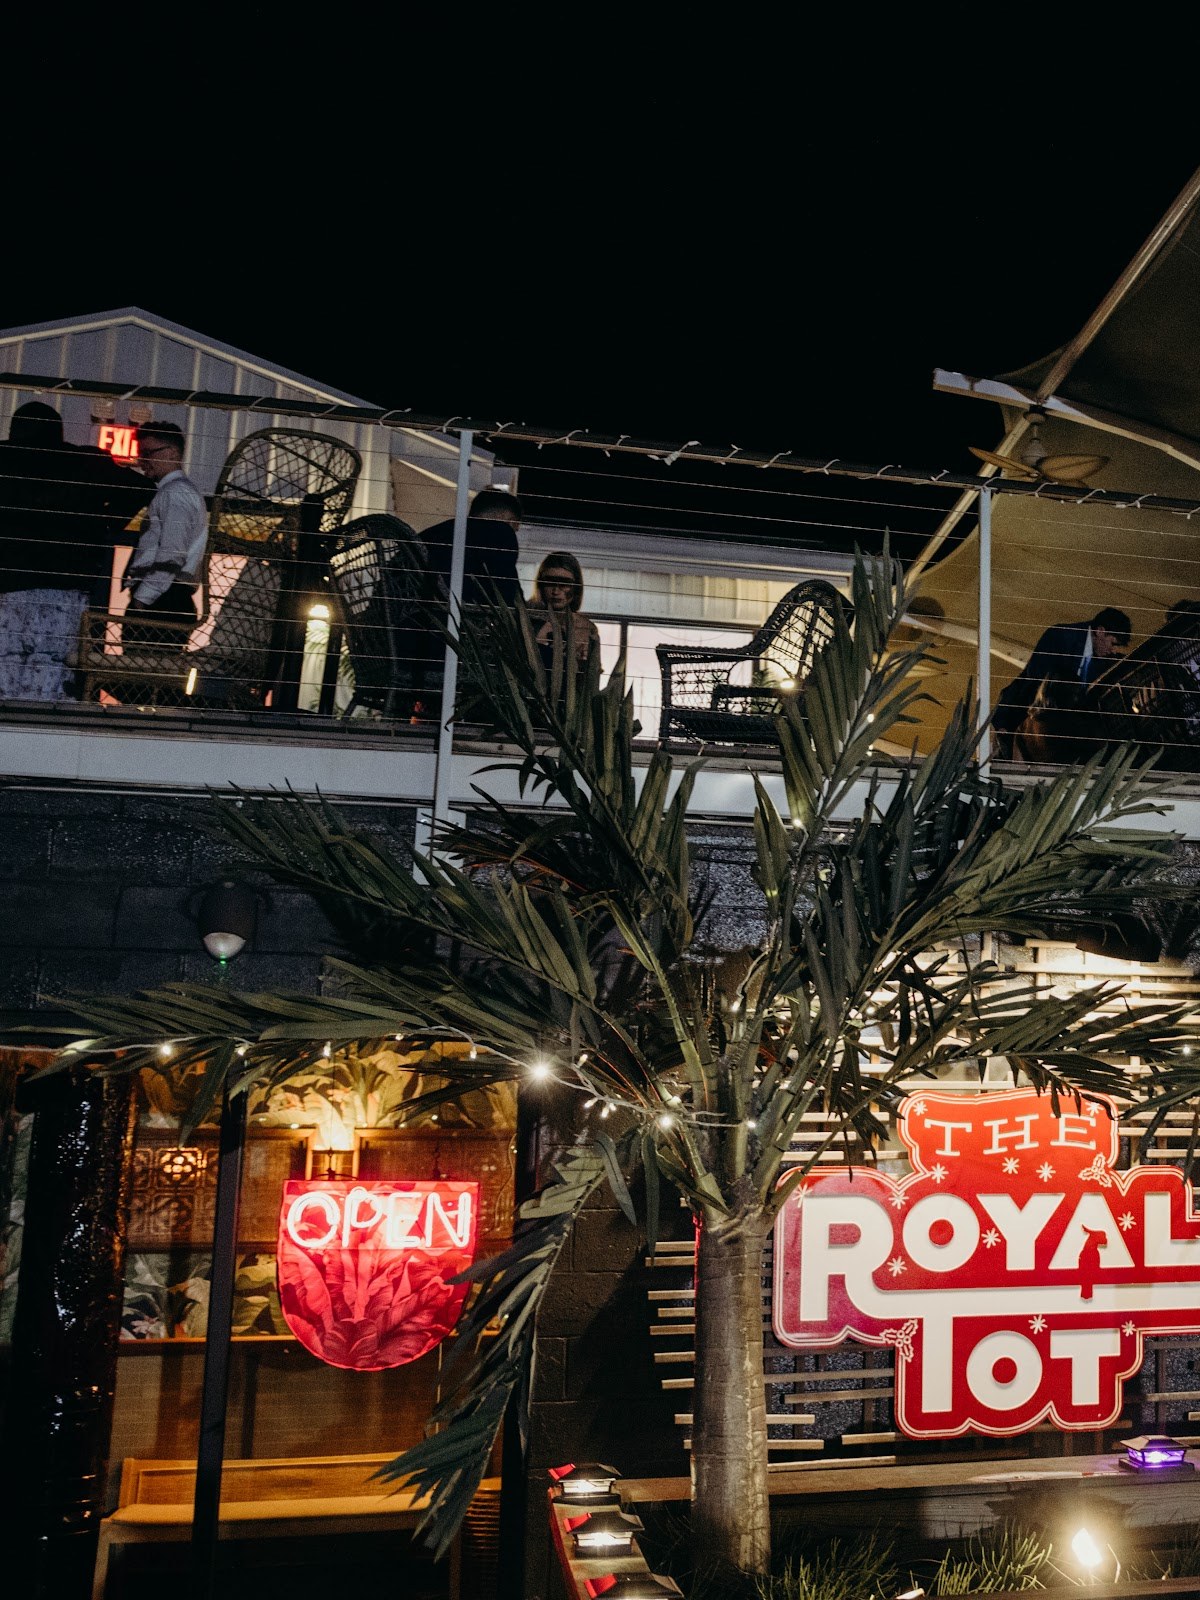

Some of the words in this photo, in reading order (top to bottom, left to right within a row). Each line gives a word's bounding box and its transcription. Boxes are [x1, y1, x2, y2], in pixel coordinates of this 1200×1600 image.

[924, 1111, 1098, 1156] THE
[286, 1186, 472, 1248] OPEN
[921, 1304, 1121, 1413] TOT
